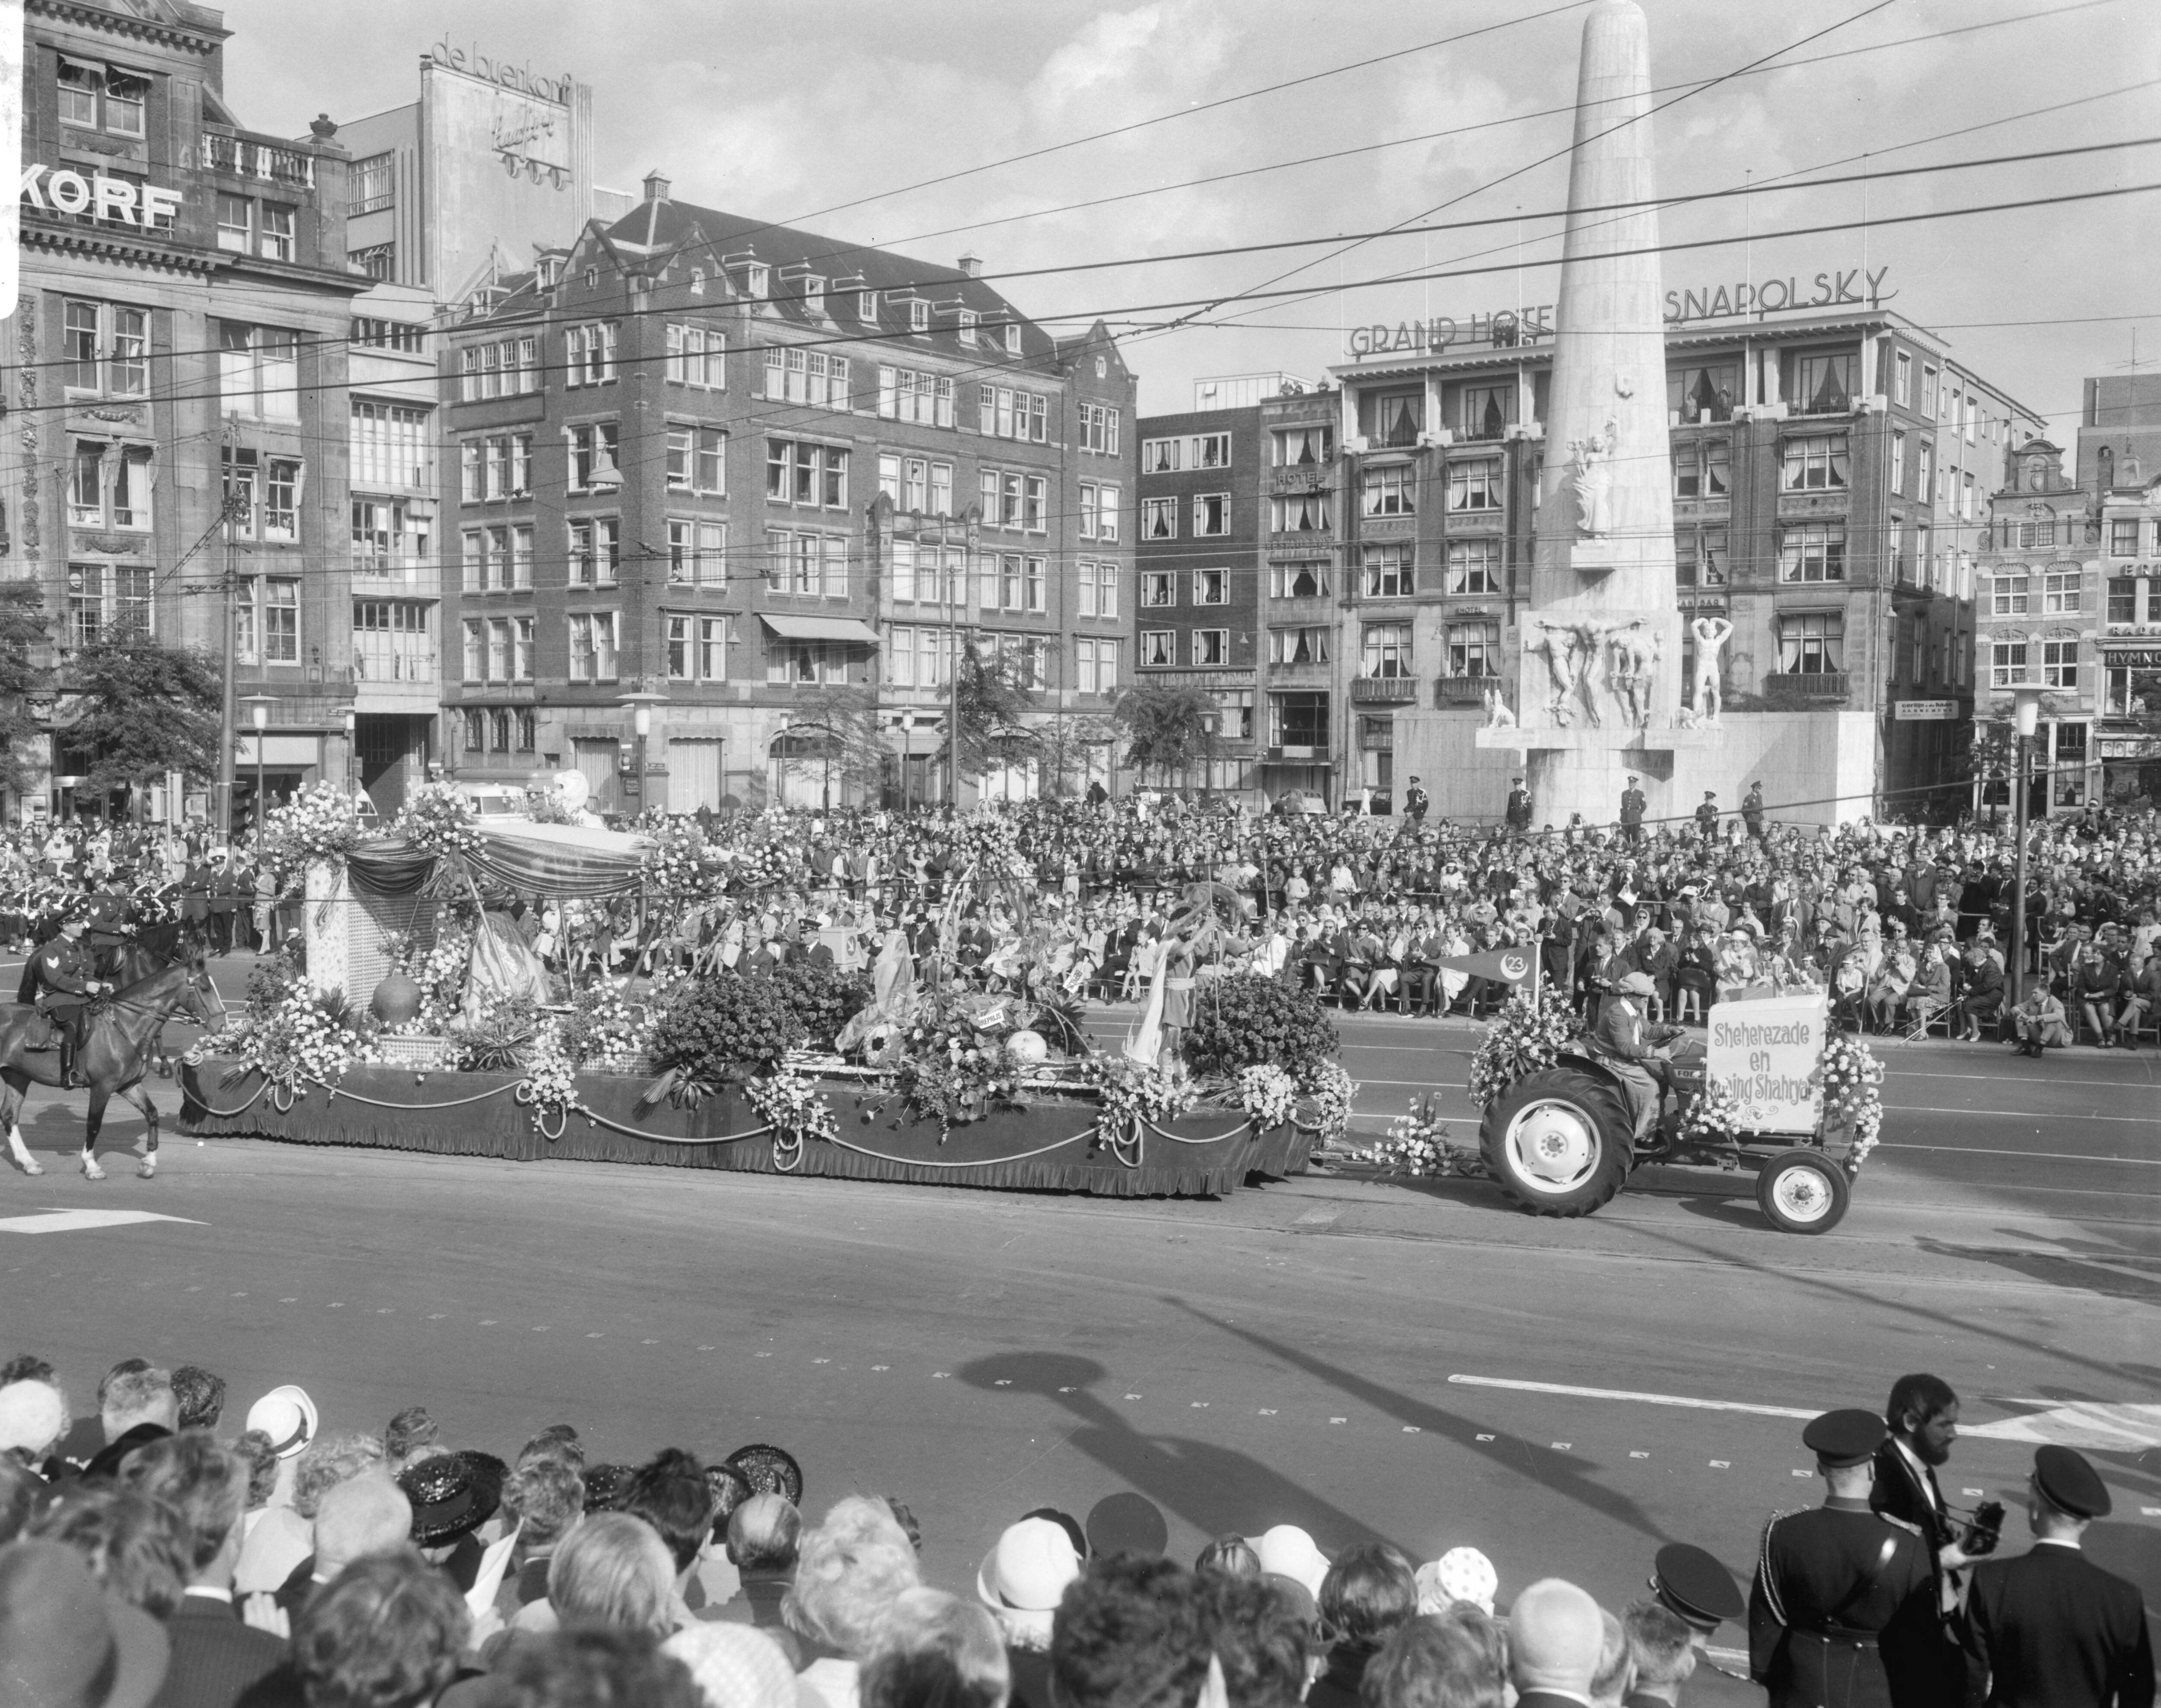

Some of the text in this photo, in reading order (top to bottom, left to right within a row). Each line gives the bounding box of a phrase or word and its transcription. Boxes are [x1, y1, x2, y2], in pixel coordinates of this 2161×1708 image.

[433, 32, 465, 71] de
[21, 163, 182, 228] KORF
[1349, 317, 1456, 354] GRAND
[1278, 471, 1326, 485] HOTEL
[1508, 956, 1524, 970] 23
[1714, 1020, 1810, 1048] Sheherezade
[1750, 1050, 1770, 1073] en
